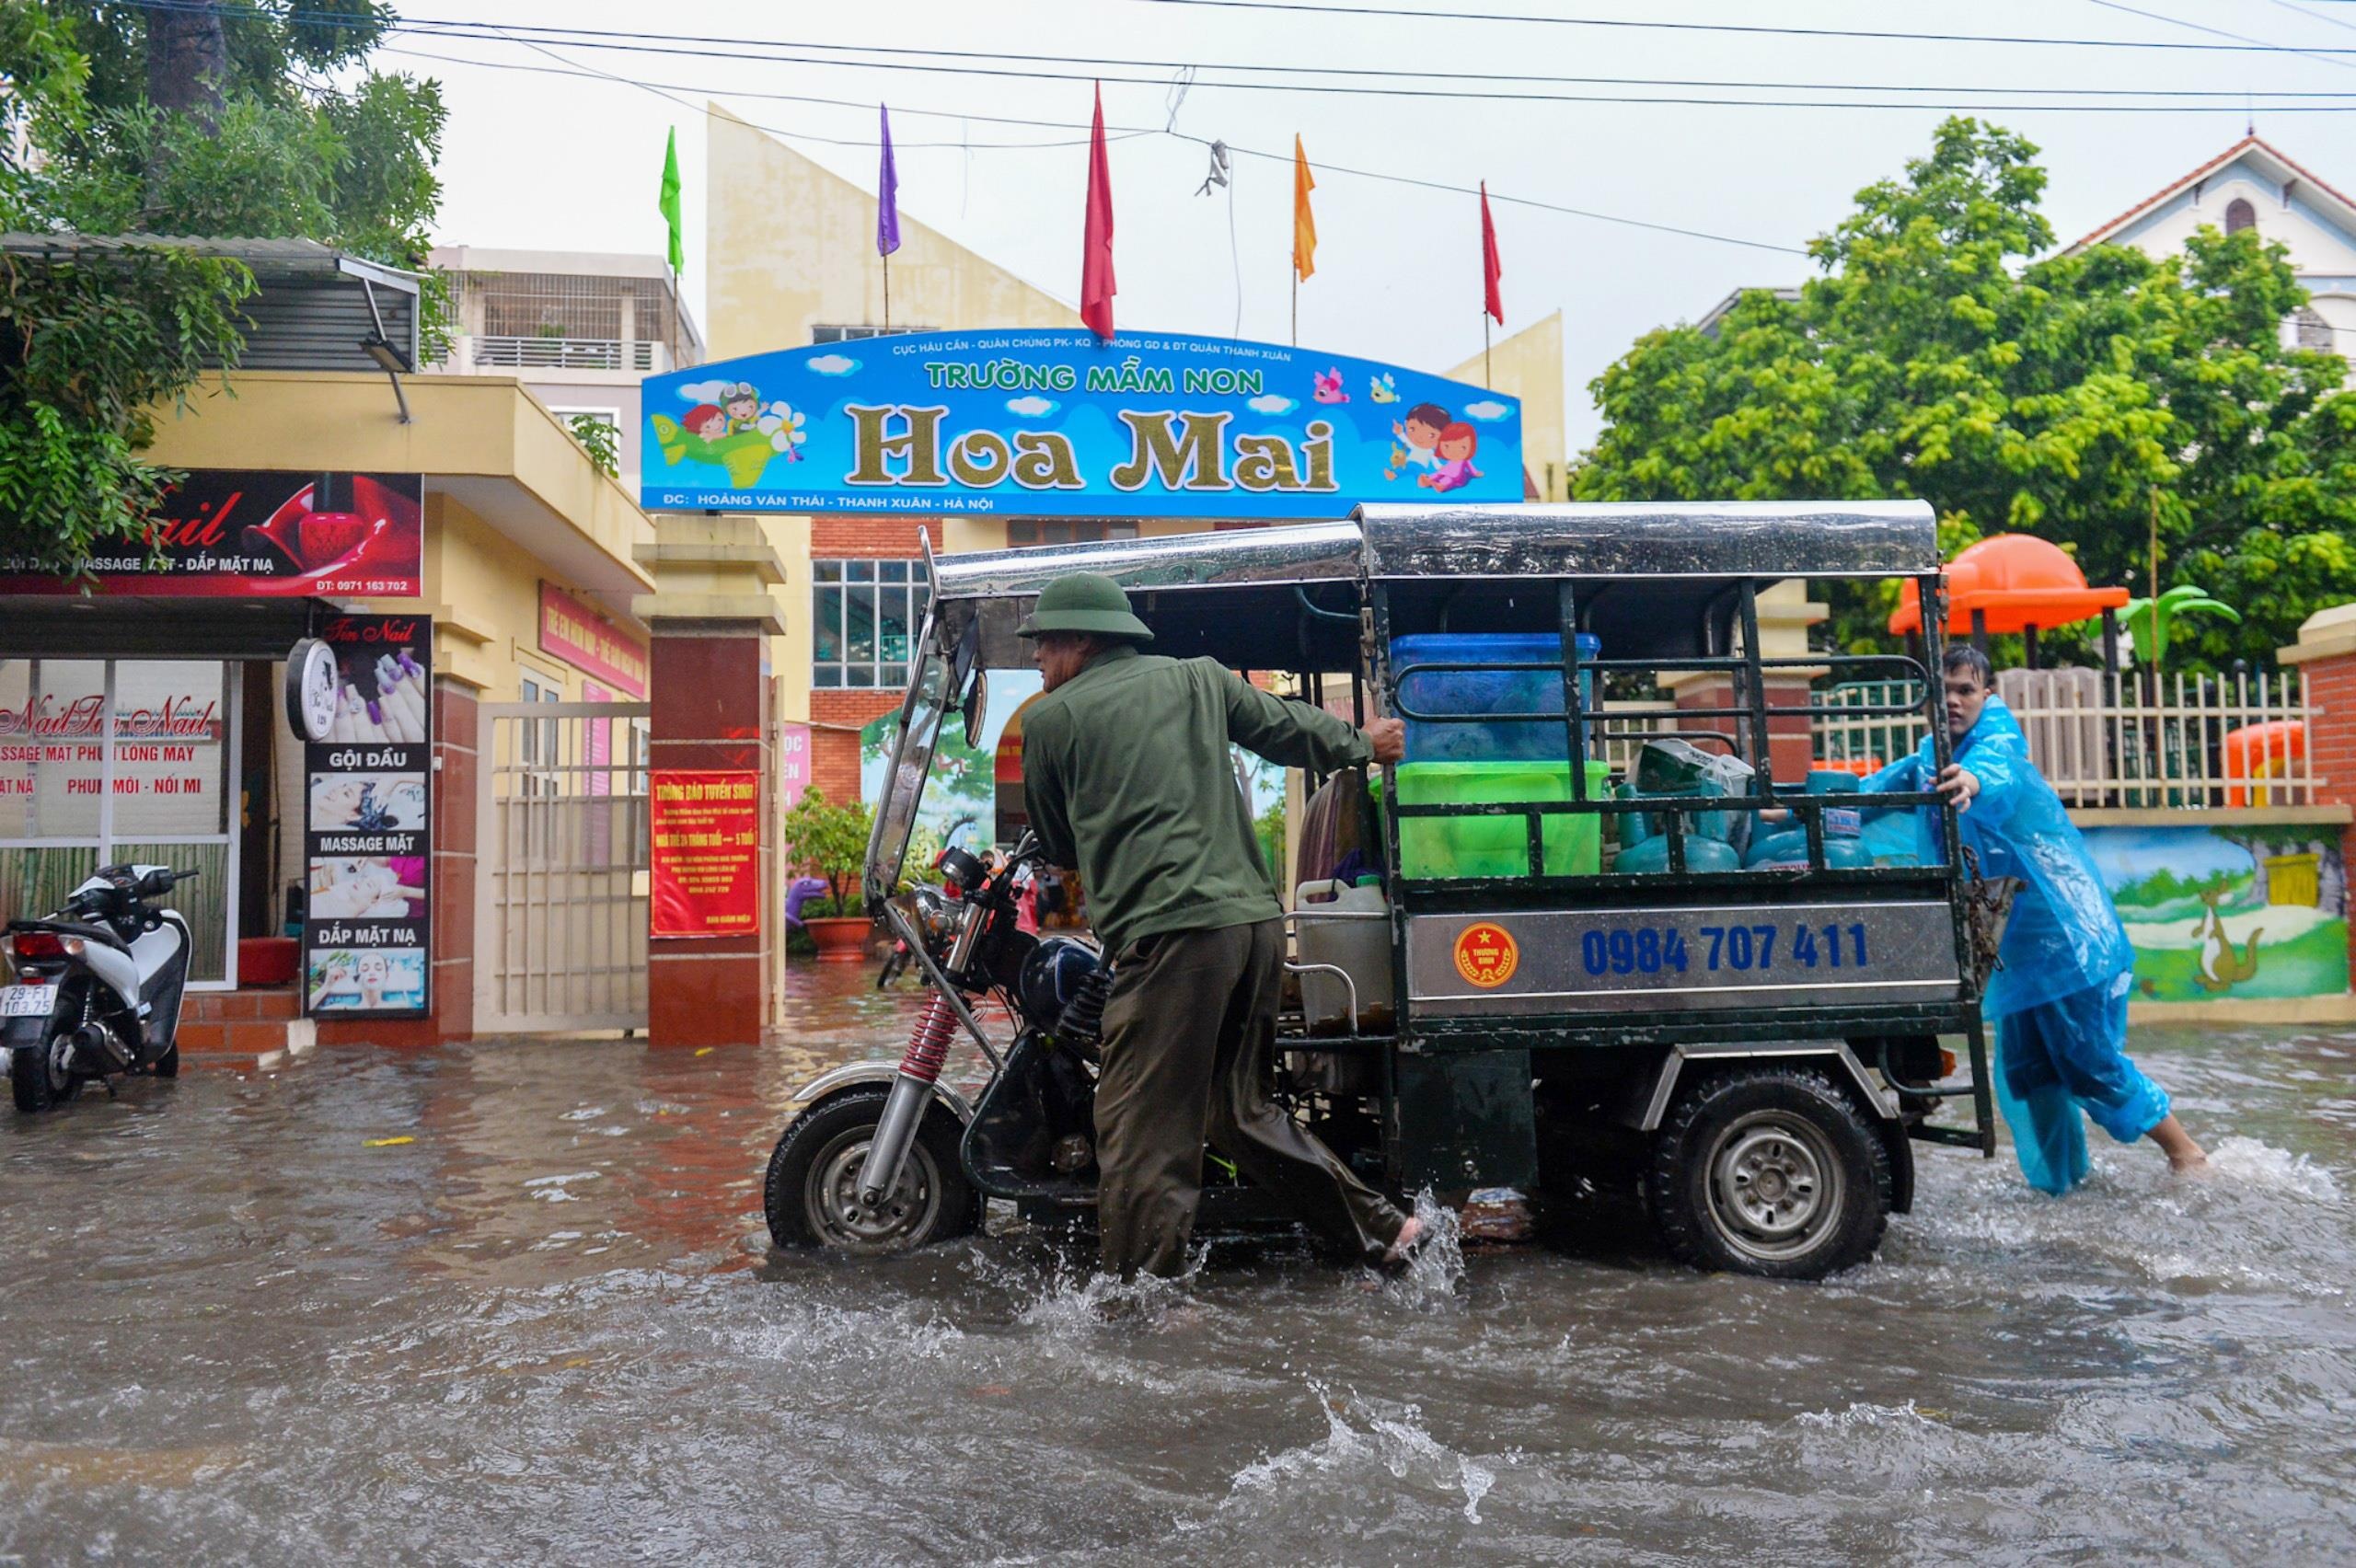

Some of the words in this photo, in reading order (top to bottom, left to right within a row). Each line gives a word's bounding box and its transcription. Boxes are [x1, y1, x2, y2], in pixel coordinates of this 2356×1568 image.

[1145, 340, 1161, 350] GD
[1163, 340, 1171, 350] &
[1223, 345, 1260, 358] THANH
[925, 358, 1077, 391] TRƯỜNG
[1087, 355, 1174, 393] MẦM
[1184, 367, 1264, 396] NON
[843, 403, 1087, 490] Hoa
[1109, 409, 1341, 493] Mai
[123, 482, 244, 546] ail
[663, 494, 689, 504] ĐC:
[698, 492, 752, 505] HOÀNG
[756, 495, 787, 506] VĂN
[791, 496, 825, 507] THÁI
[837, 497, 887, 507] THANH
[891, 497, 931, 508] XUÂN
[944, 497, 964, 509] HÀ
[968, 497, 993, 512] NỘI
[187, 550, 215, 571] ĐẮP
[219, 555, 248, 575] MẶT
[253, 558, 274, 575] NẠ
[363, 617, 417, 643] Nail
[130, 695, 216, 735] Nail
[329, 748, 363, 771] GỘI
[366, 746, 408, 767] ĐẦU
[184, 778, 201, 794] MI
[320, 836, 383, 852] MASSAGE
[386, 833, 415, 855] MẶT
[318, 920, 352, 945] ĐẮP
[355, 925, 390, 948] MẶT
[393, 928, 417, 947] NẠ
[1582, 928, 1689, 975] 0984
[1700, 925, 1777, 971] 707
[1792, 923, 1867, 968] 411
[9, 986, 49, 1000] 29-F1
[5, 1000, 50, 1015] 103.75
